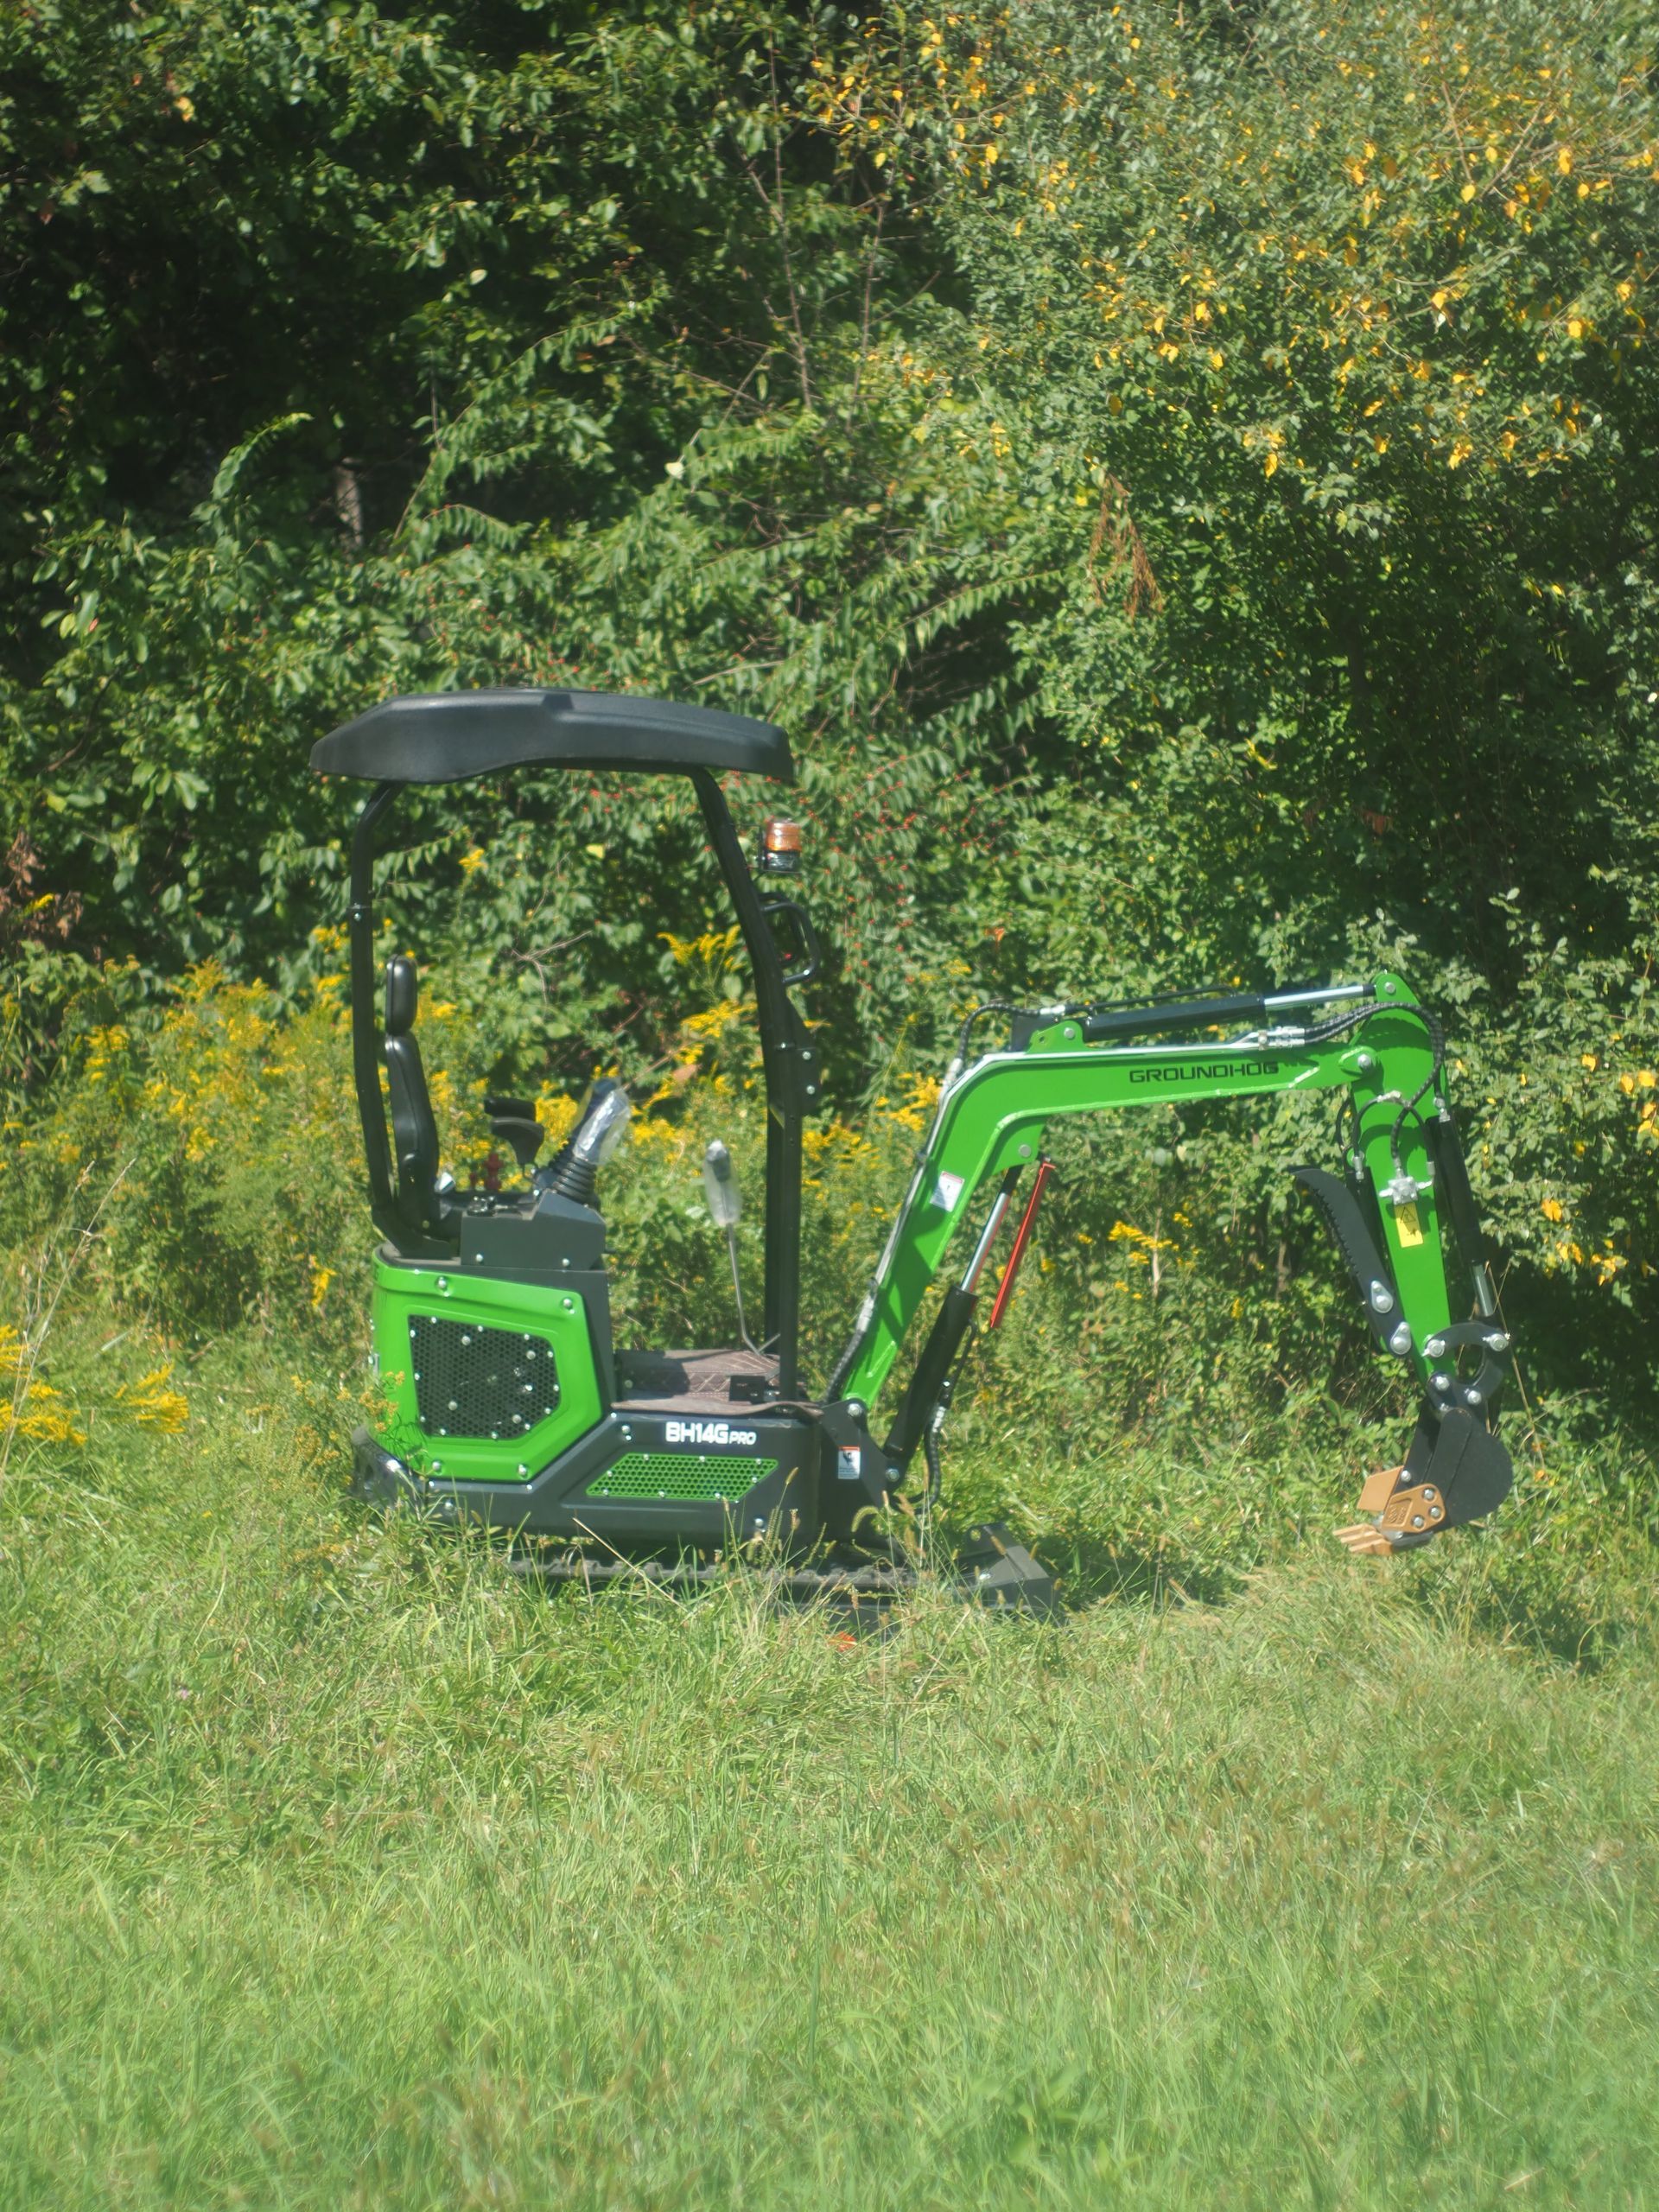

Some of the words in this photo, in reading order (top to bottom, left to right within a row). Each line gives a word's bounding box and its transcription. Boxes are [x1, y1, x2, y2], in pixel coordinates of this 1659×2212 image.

[1129, 1061, 1279, 1083] GROUNDHOG
[665, 1421, 728, 1444] BH14G
[728, 1431, 757, 1445] PRO
